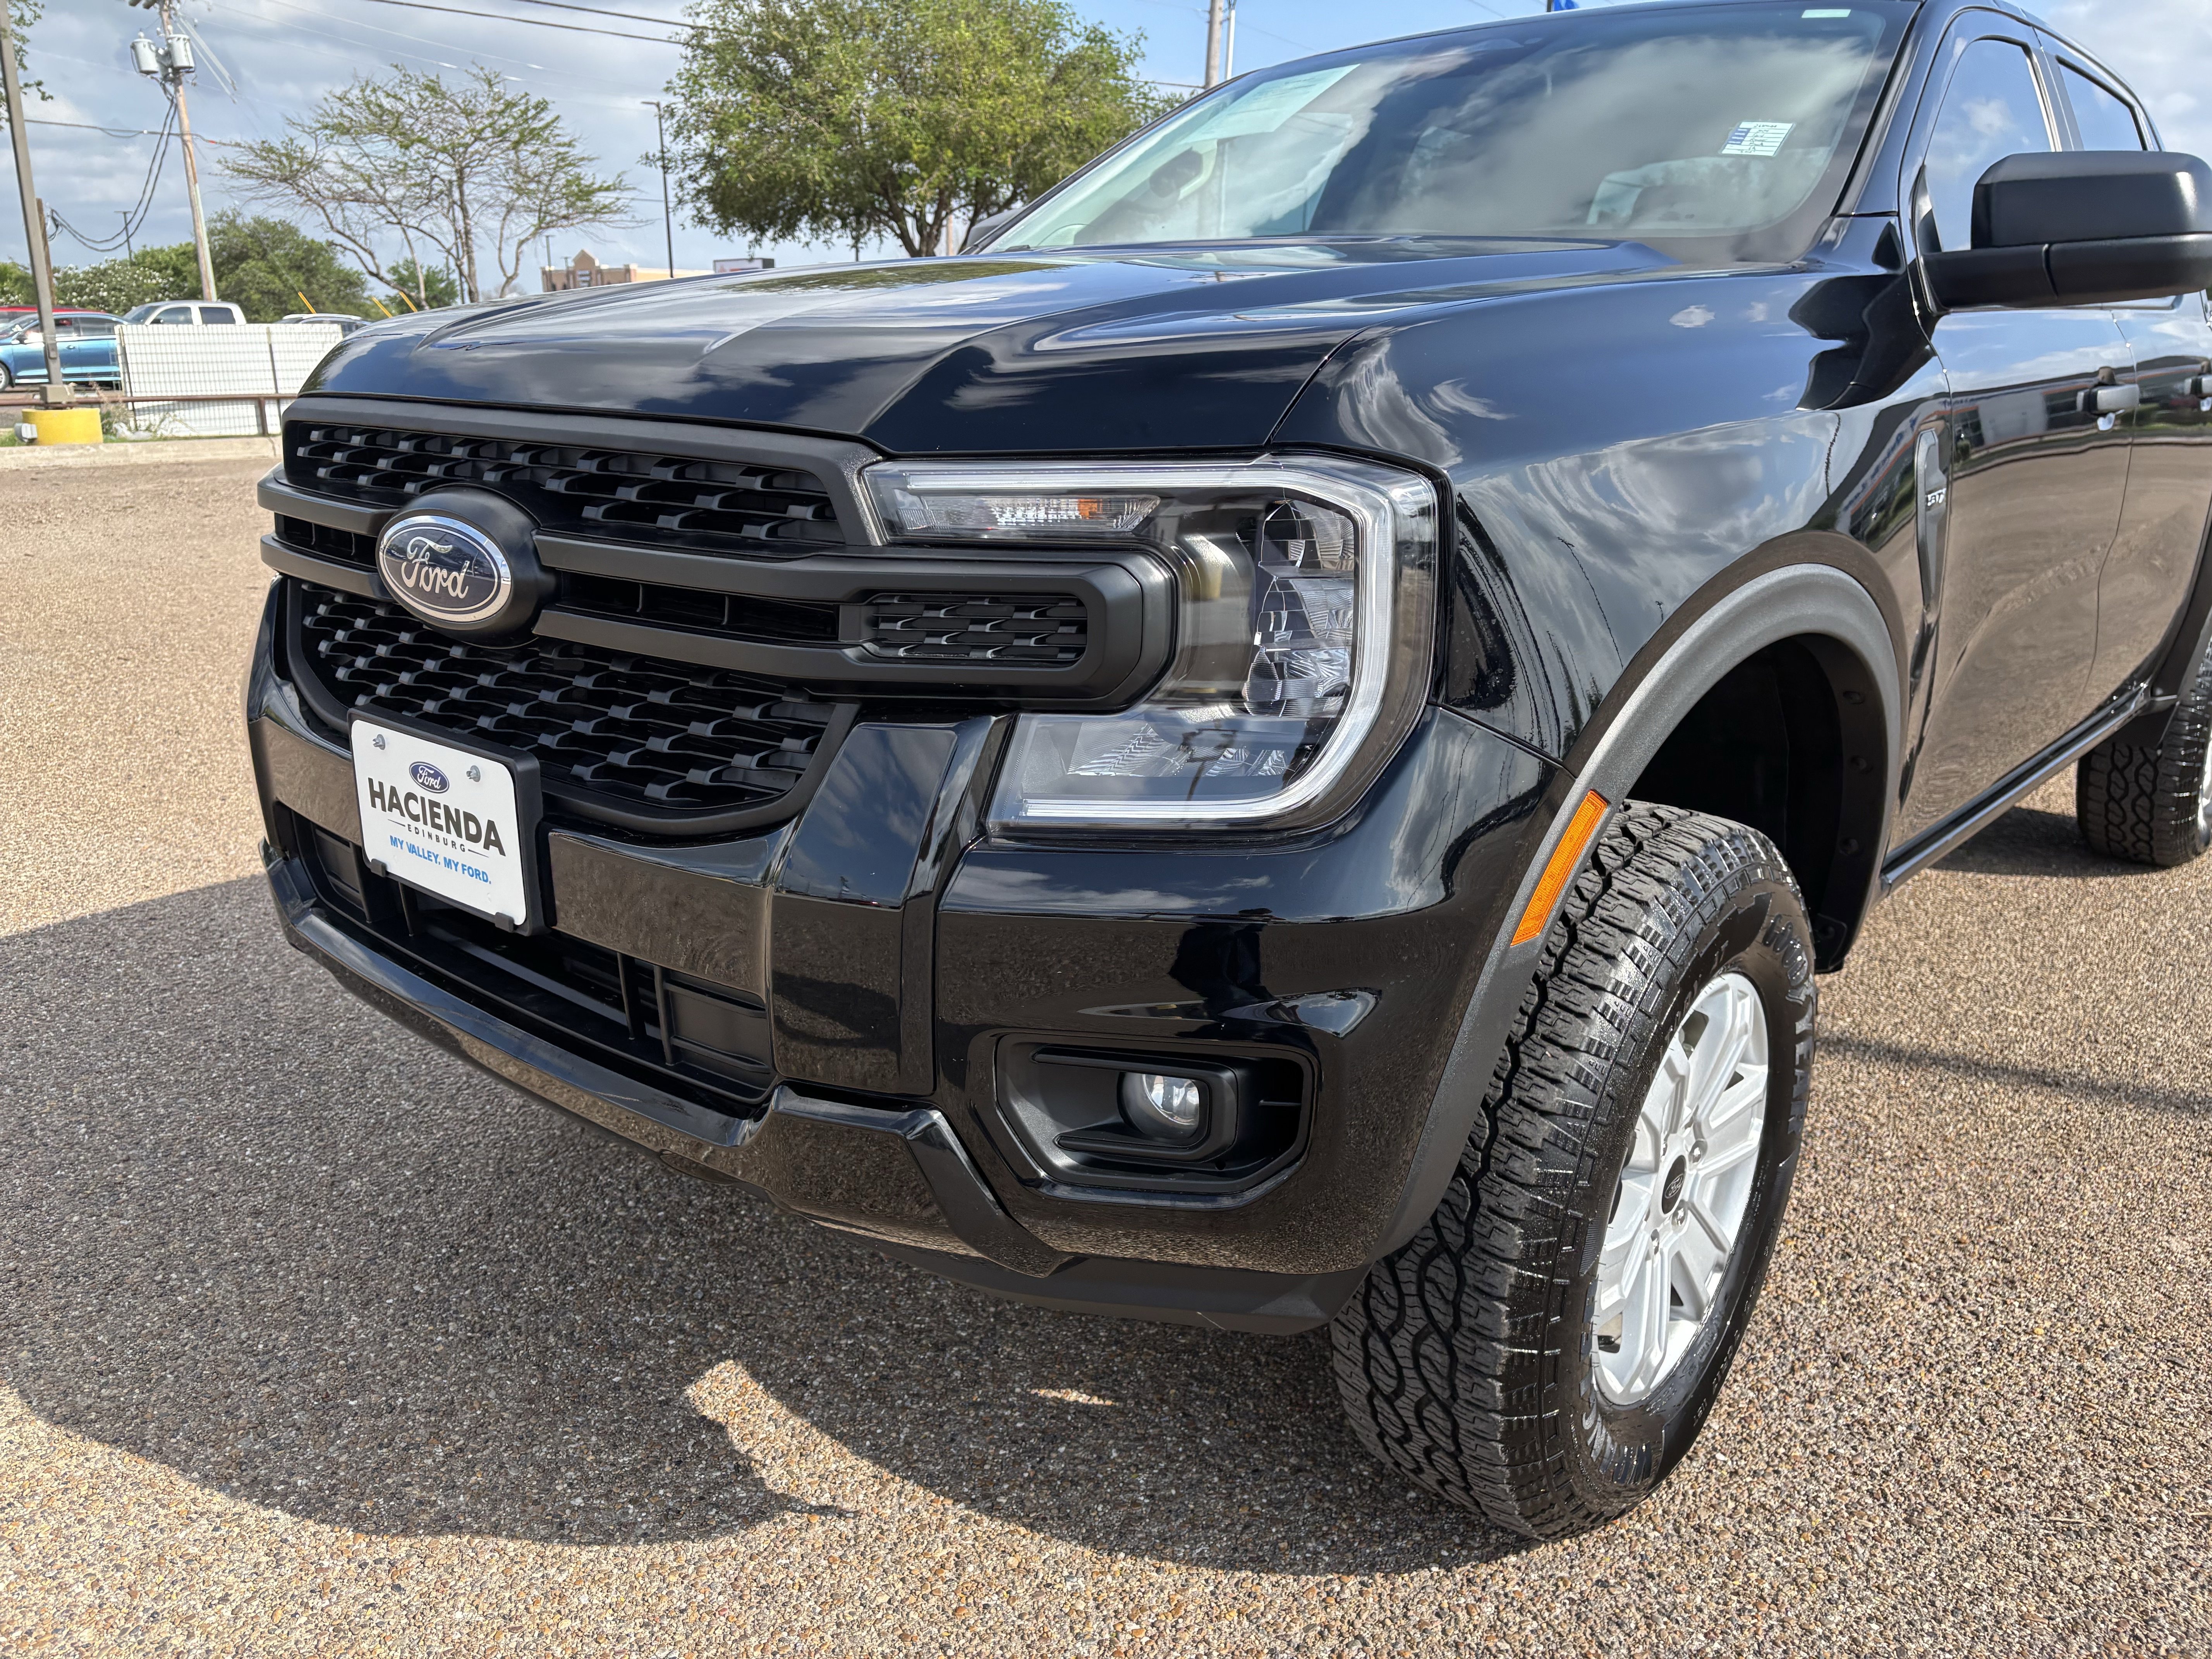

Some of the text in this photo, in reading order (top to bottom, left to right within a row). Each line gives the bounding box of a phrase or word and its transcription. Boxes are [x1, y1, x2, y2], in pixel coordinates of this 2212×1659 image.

[401, 536, 470, 599] Ford
[417, 765, 441, 790] Ford
[368, 777, 506, 857] HACIENDA
[407, 823, 465, 852] EDINBURG
[390, 835, 492, 884] MY VALLEY, MY FORD.
[1763, 914, 1816, 1135] GOODYEAR
